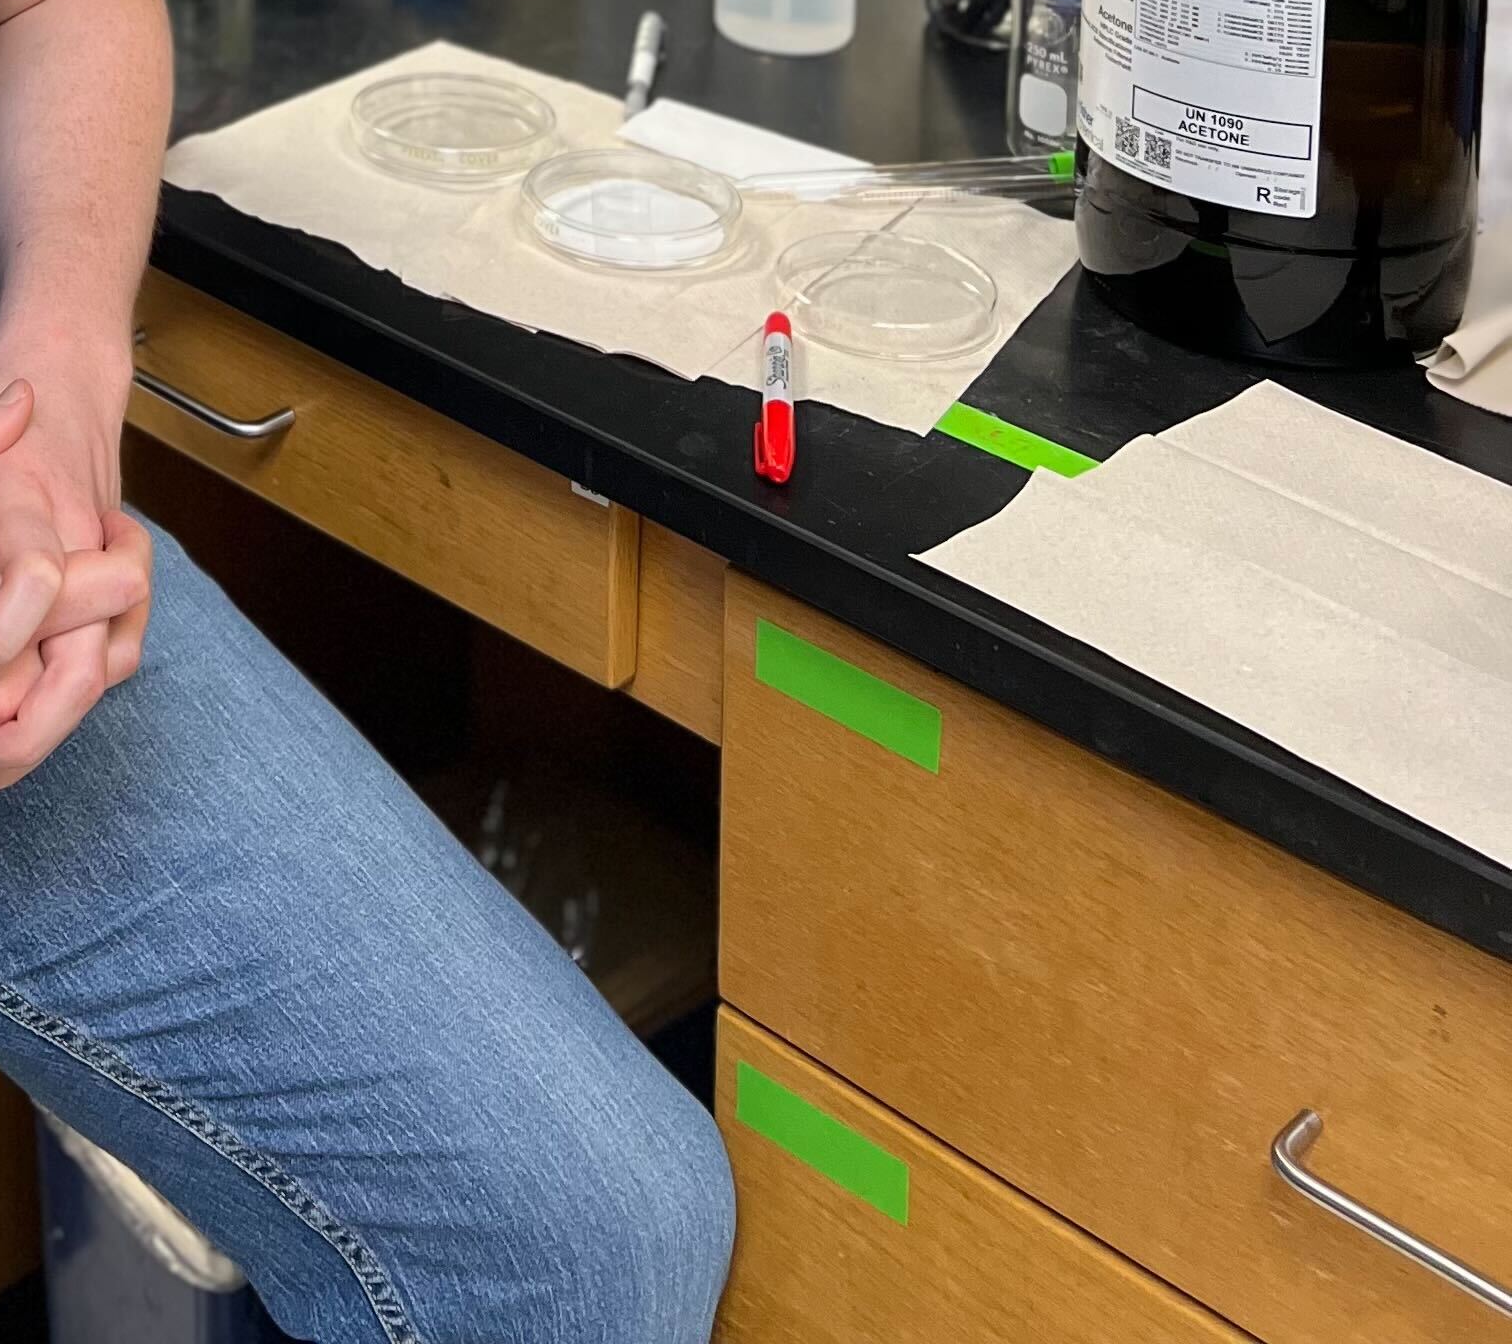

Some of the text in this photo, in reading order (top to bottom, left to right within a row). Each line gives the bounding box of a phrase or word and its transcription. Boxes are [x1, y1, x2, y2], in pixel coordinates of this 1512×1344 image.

[1098, 5, 1134, 33] Acetone
[1026, 41, 1069, 65] 250 mL
[1185, 107, 1244, 131] UN 1090
[1178, 119, 1251, 147] ACETONE
[1256, 186, 1272, 204] R
